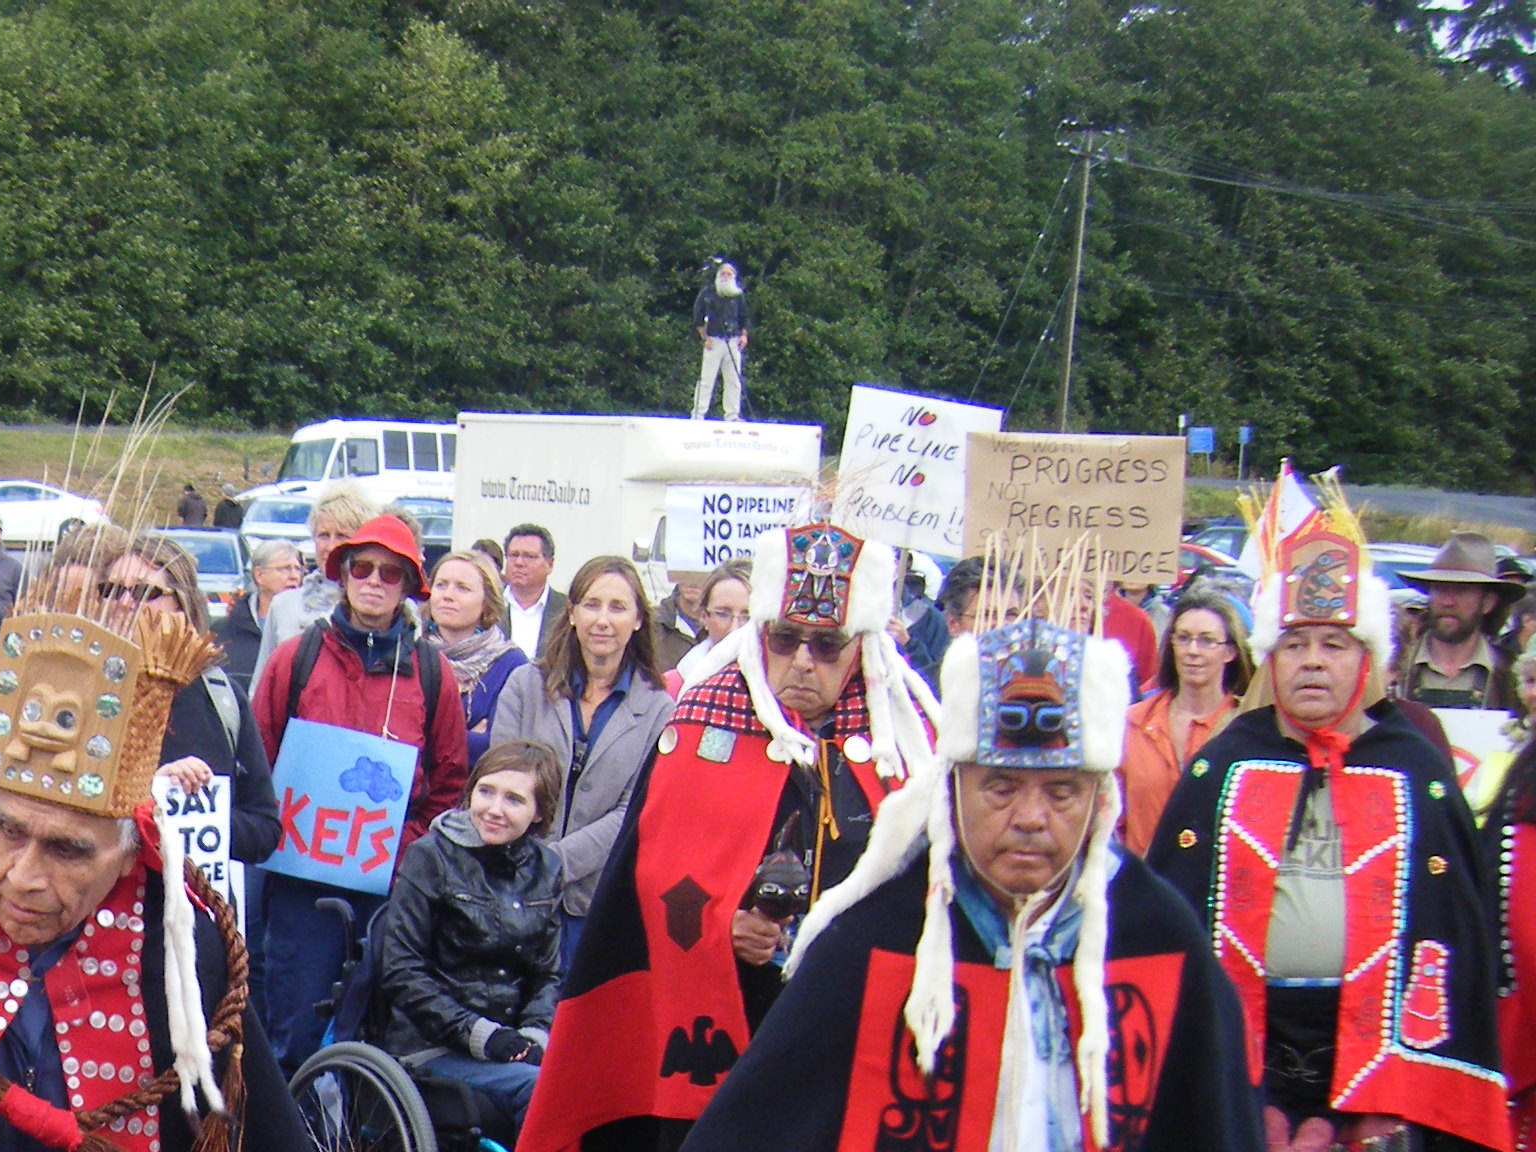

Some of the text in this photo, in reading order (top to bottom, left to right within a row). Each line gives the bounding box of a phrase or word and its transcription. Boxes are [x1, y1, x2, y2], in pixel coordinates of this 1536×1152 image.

[900, 405, 937, 427] NO
[854, 423, 960, 461] PIPELINE
[889, 463, 926, 487] NO
[1009, 454, 1169, 485] PROGRESS
[702, 493, 796, 515] NO PIPELINE
[988, 481, 1031, 501] NOT
[1007, 501, 1151, 529] REGRESS
[703, 518, 733, 541] NO
[703, 544, 733, 566] NO
[1056, 547, 1175, 575] EBRIDGE
[165, 784, 221, 817] SAY
[178, 824, 222, 855] TO
